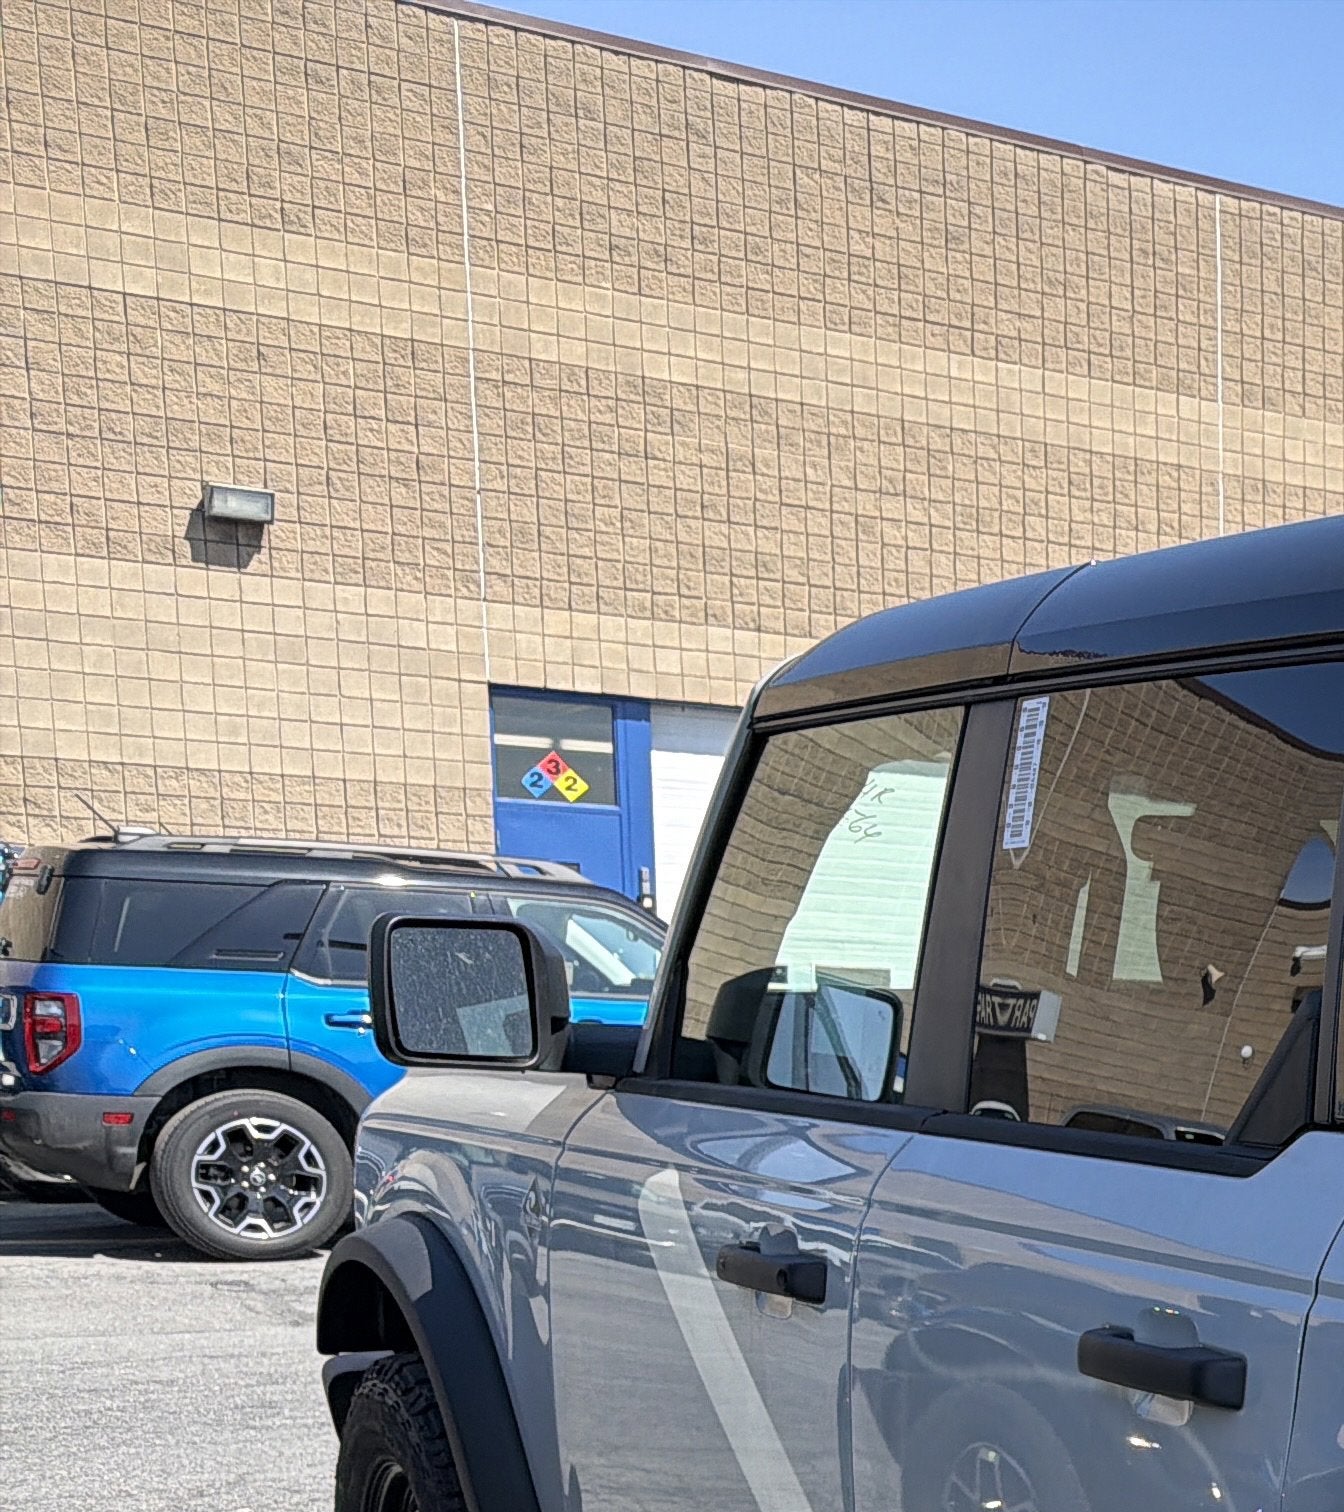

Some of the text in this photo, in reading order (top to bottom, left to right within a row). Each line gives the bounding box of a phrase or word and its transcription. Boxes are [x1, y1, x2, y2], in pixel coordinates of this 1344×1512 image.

[546, 758, 560, 775] 3
[529, 772, 543, 788] 2
[565, 776, 578, 792] 2
